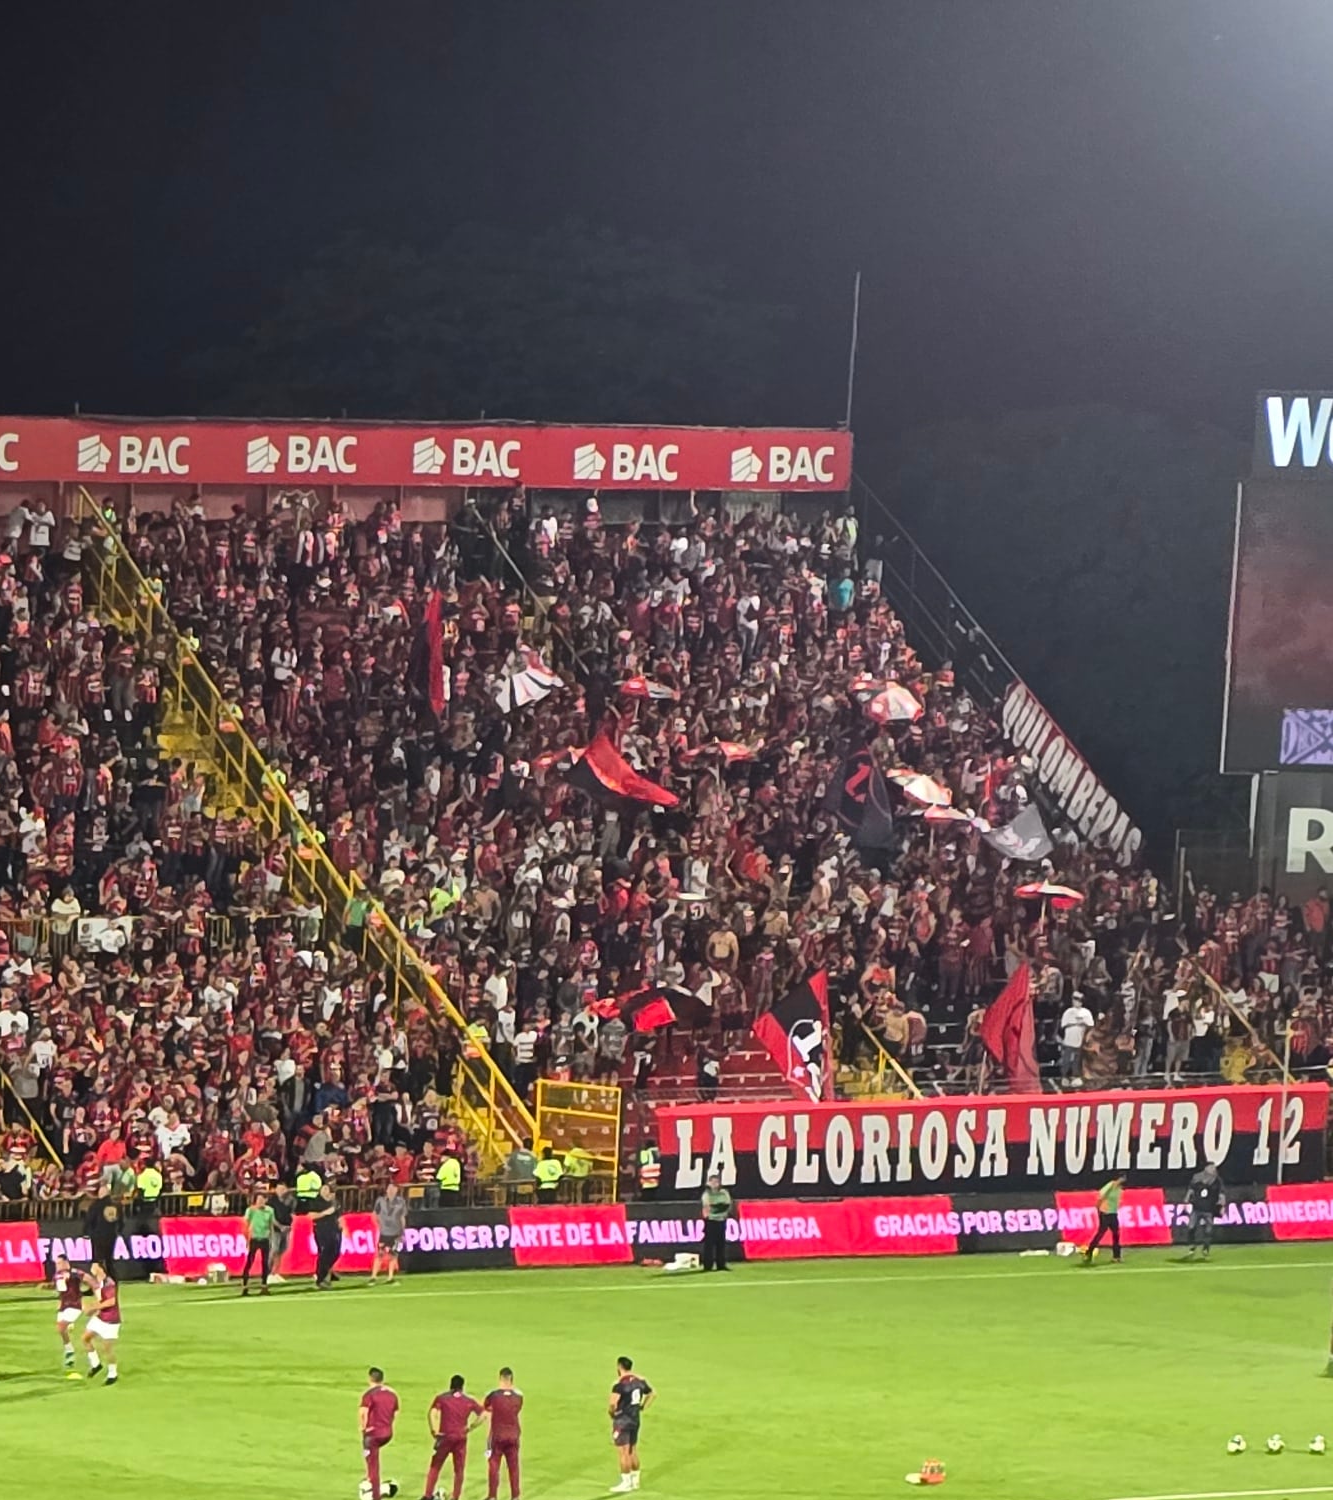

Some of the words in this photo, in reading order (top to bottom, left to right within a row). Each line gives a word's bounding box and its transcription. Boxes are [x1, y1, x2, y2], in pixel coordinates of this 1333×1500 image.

[1267, 396, 1333, 468] W
[118, 436, 191, 475] BAC
[287, 434, 358, 474] BAC
[452, 438, 521, 479] BAC
[612, 443, 680, 482] BAC
[768, 446, 835, 483] BAC
[675, 1117, 737, 1189] LA
[757, 1107, 1009, 1186] GLORIOSA
[1026, 1097, 1233, 1177] NUMERO
[1252, 1096, 1304, 1166] 12
[405, 1227, 450, 1253] POR
[451, 1225, 494, 1251] SER
[496, 1222, 565, 1249] PARTE
[567, 1222, 594, 1247] DE
[595, 1221, 625, 1246] LA
[725, 1216, 822, 1243] OJINEGRA
[875, 1212, 962, 1239] GRACIAS
[962, 1209, 1003, 1235] POR
[1004, 1208, 1044, 1233] SER
[1043, 1206, 1099, 1231] PART
[1137, 1204, 1164, 1227] LA
[7, 1239, 38, 1263] LA
[37, 1235, 130, 1263] FAMIA
[131, 1233, 249, 1260] ROJINEGRA
